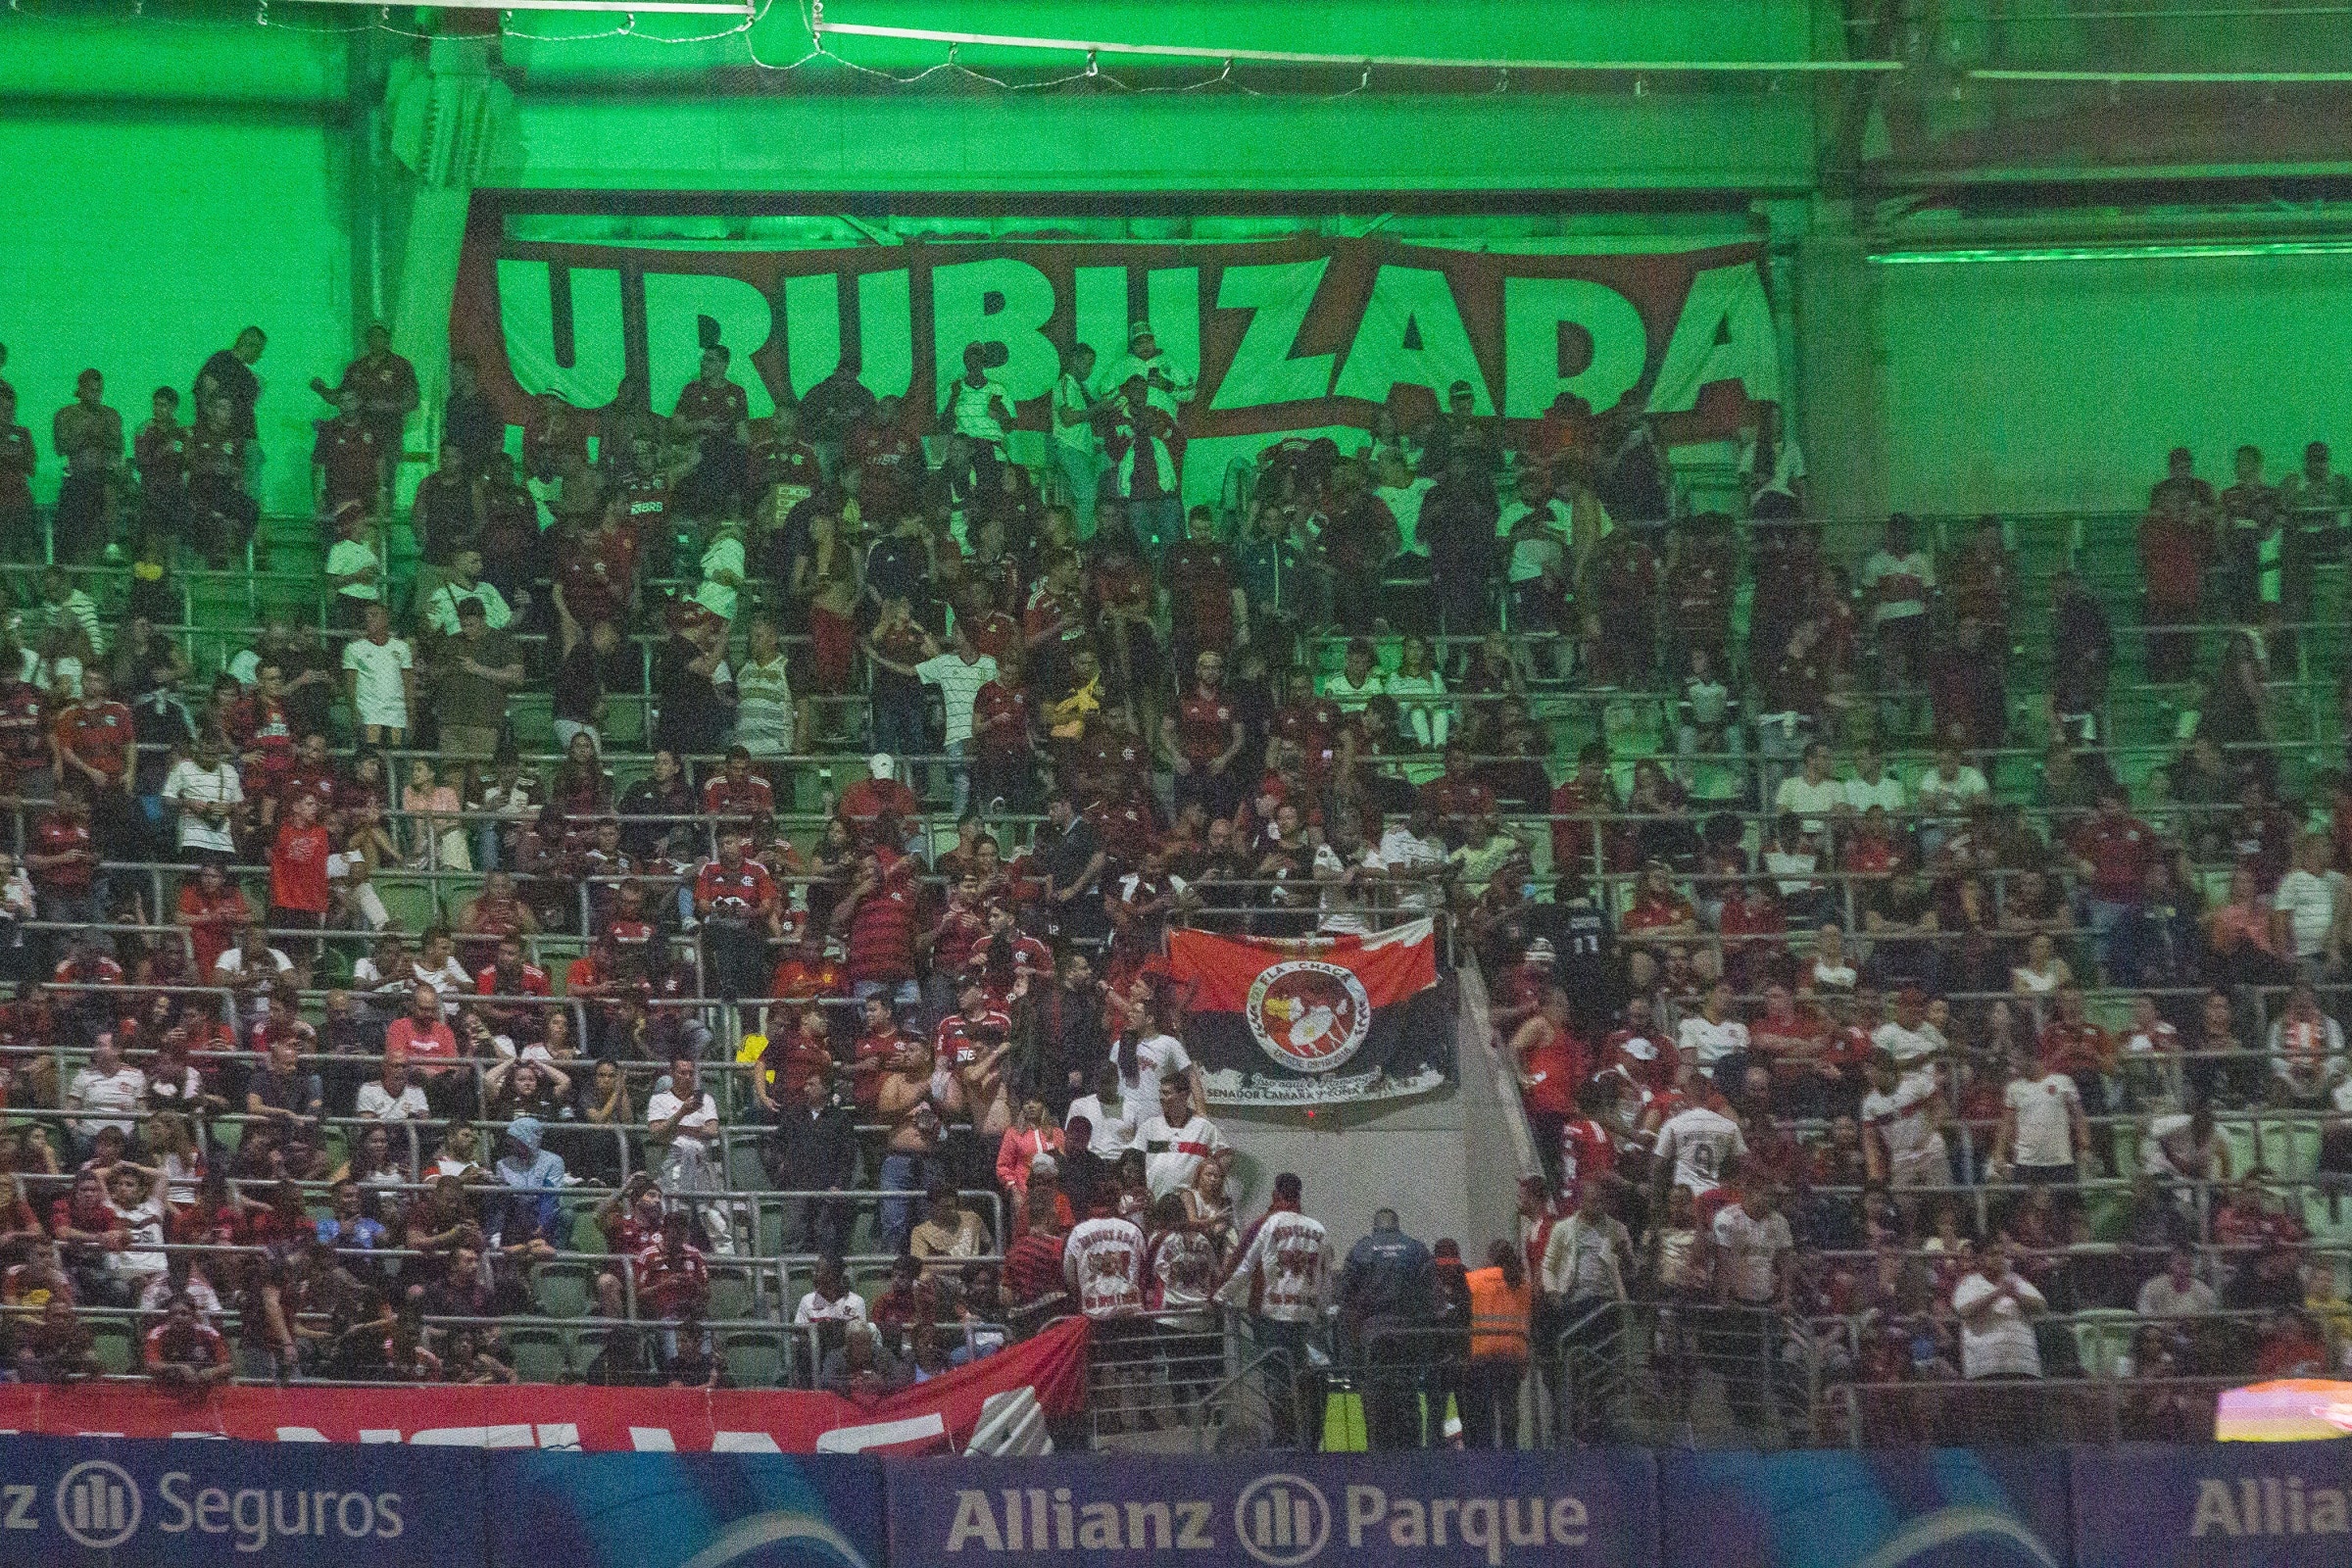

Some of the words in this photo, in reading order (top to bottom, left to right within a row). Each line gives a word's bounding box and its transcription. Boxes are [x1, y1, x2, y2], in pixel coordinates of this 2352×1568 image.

[496, 256, 1781, 418] URUBUZADA
[1206, 1088, 1259, 1100] SENADOR
[159, 1472, 405, 1552] Seguros
[947, 1487, 1214, 1550] Allianz
[1348, 1486, 1589, 1566] Parque
